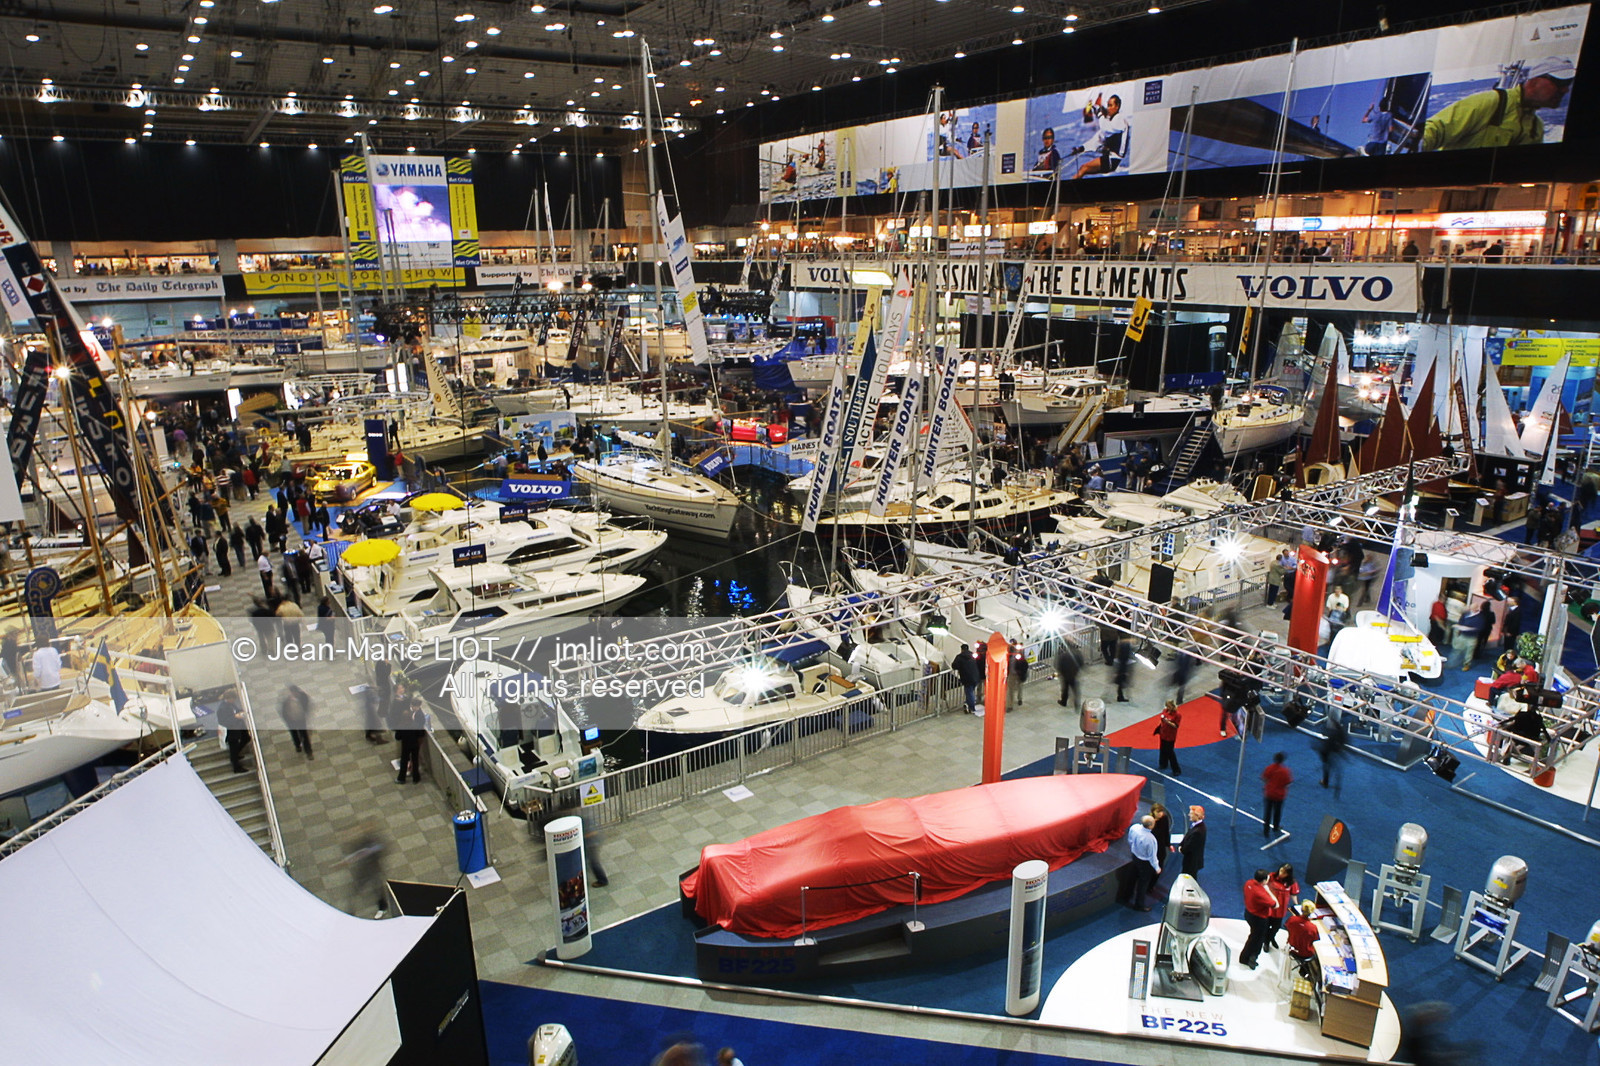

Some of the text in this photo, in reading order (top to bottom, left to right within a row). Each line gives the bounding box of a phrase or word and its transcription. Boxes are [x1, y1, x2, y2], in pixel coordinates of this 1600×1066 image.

[390, 163, 443, 177] YAMAHA
[96, 282, 121, 293] The
[126, 282, 158, 293] Daily
[162, 280, 219, 293] Telegraph
[259, 271, 336, 284] LONDON
[404, 268, 452, 279] SHOW
[1031, 265, 1064, 295] THE
[1070, 266, 1189, 301] ELEMENTS
[1236, 274, 1394, 302] VOLVO
[874, 311, 902, 386] HOLIDAYS
[1282, 358, 1297, 368] RS
[938, 356, 959, 412] BOATS
[823, 385, 843, 447] BOATS
[844, 378, 869, 443] SOUTHERLY
[858, 395, 880, 450] ACTIVE
[896, 378, 922, 437] BOATS
[791, 441, 816, 452] HAINES
[923, 414, 944, 479] HUNTER
[807, 450, 829, 522] HUNTER
[876, 437, 901, 507] HUNTER
[508, 484, 563, 495] VOLVO
[717, 957, 798, 975] BF225
[1139, 1004, 1224, 1021] THE NEW
[1140, 1014, 1228, 1037] BF225
